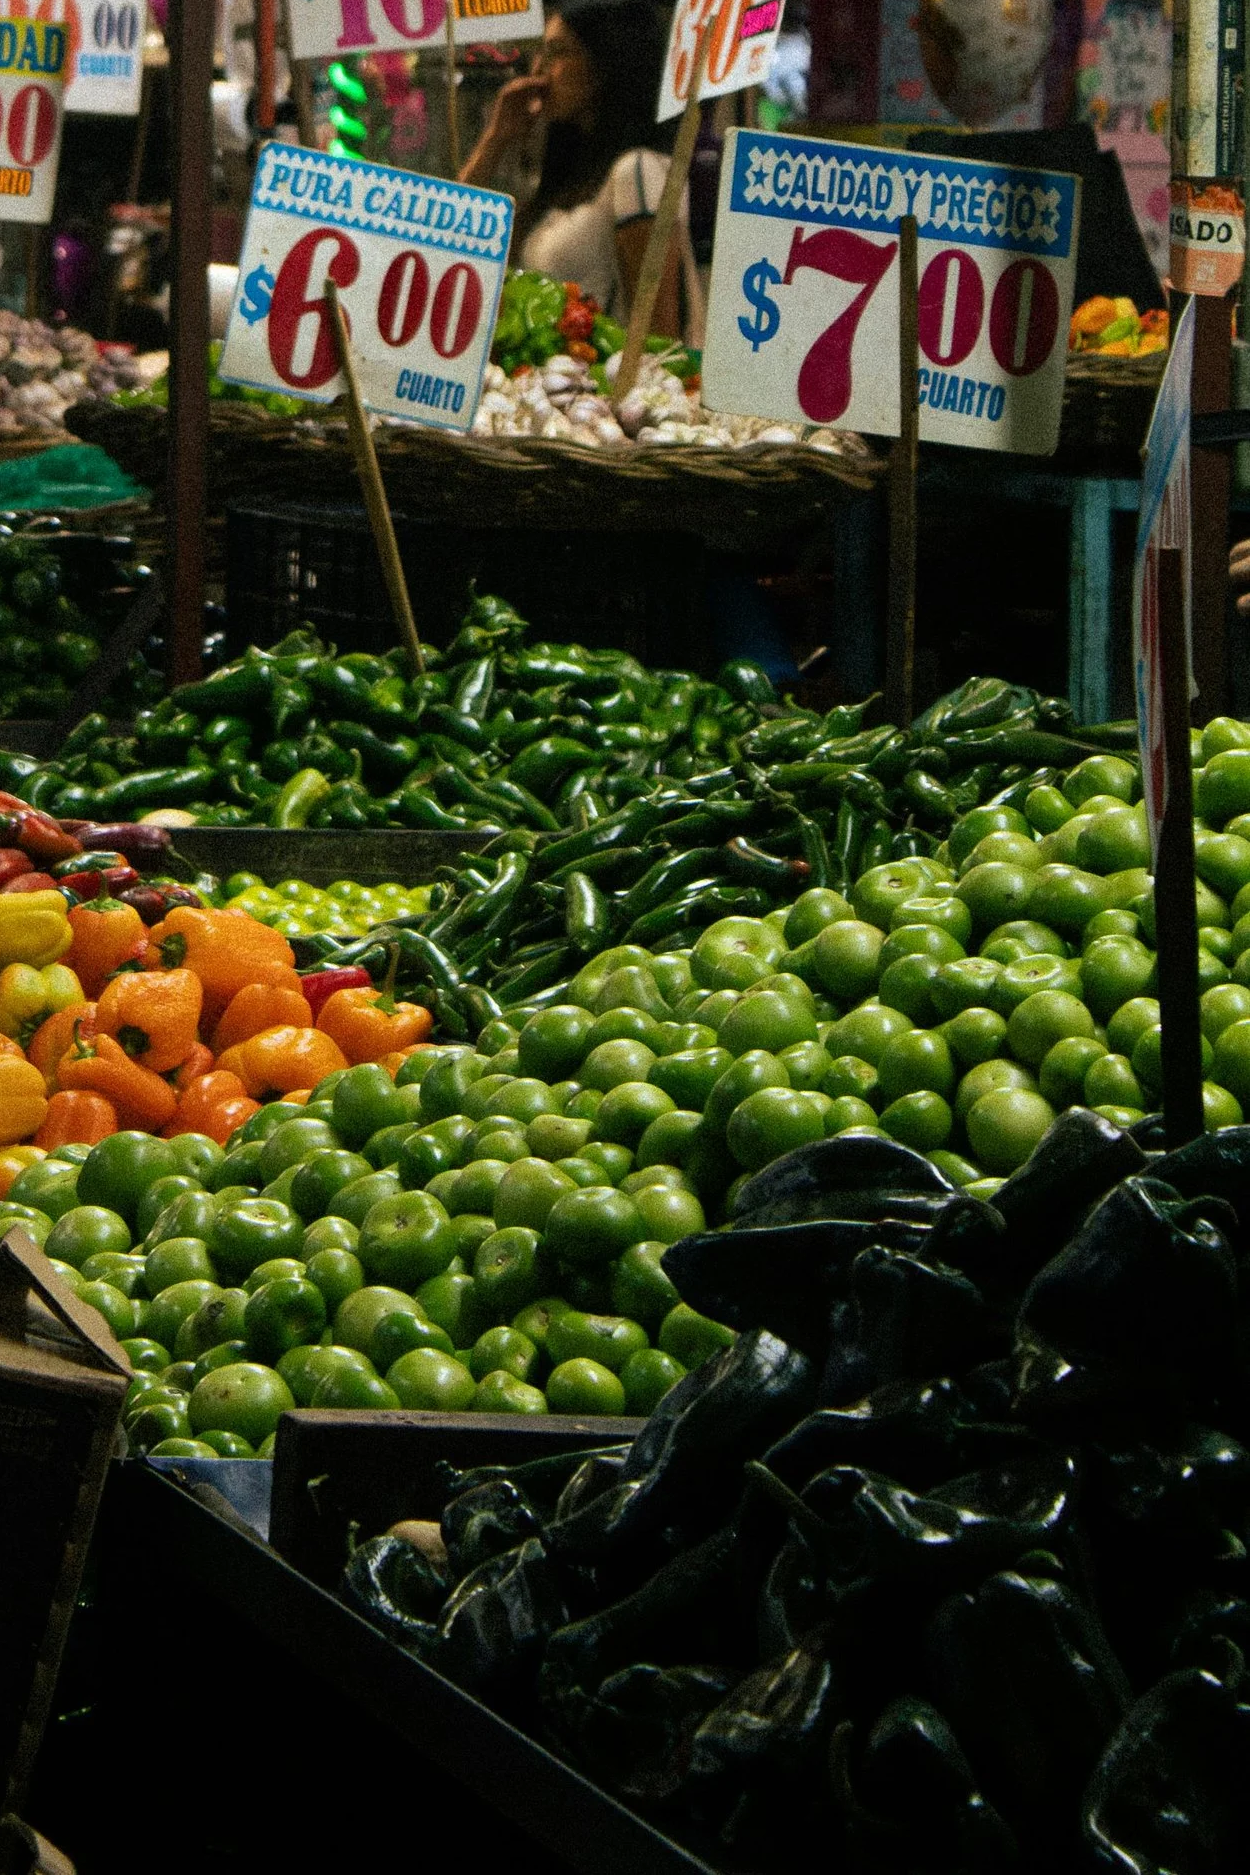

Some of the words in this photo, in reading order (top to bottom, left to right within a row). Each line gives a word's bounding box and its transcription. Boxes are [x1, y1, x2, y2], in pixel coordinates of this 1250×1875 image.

[268, 164, 352, 208] PURA
[364, 186, 498, 242] CALIDAD
[772, 159, 893, 212] CALIDAD
[903, 178, 922, 214] Y
[930, 182, 1037, 231] PRECIO
[395, 368, 466, 413] CUARTO
[917, 367, 1006, 422] CUARTO
